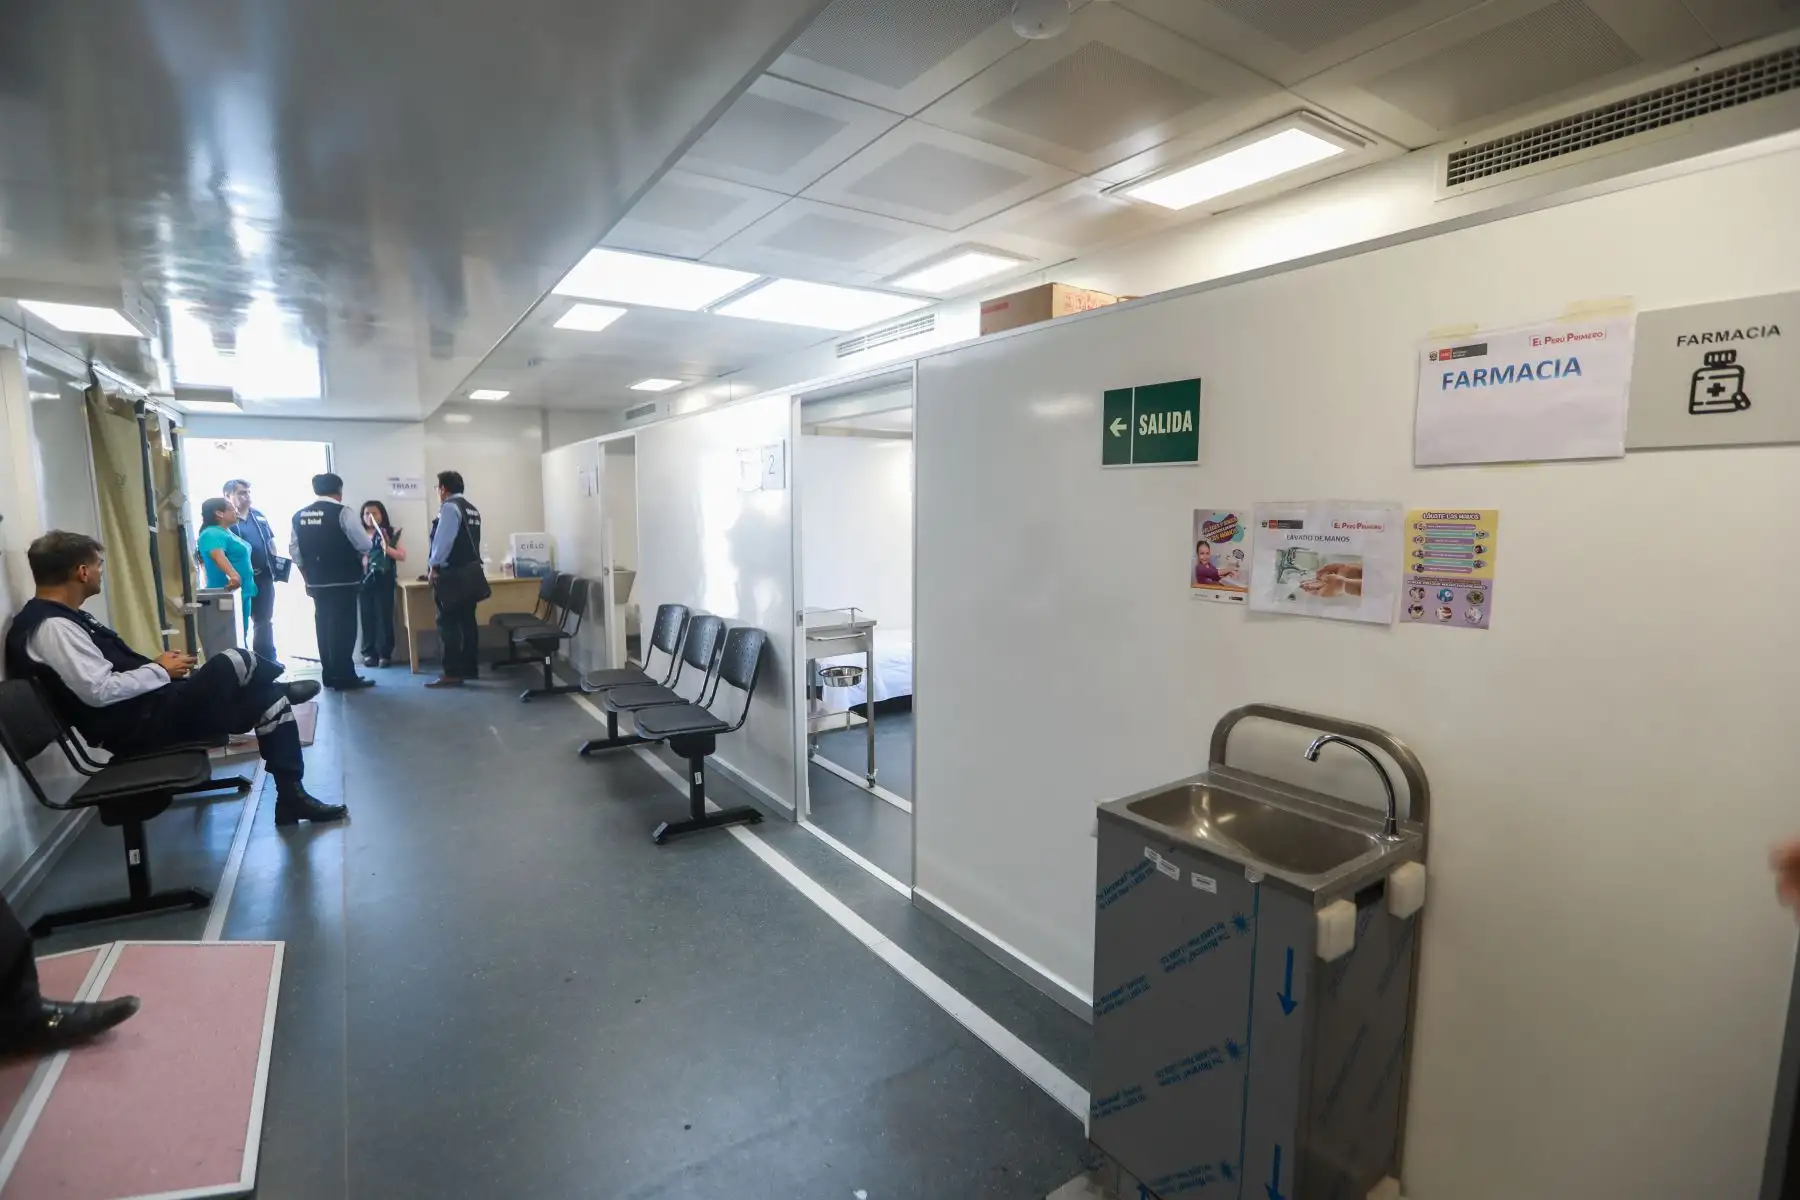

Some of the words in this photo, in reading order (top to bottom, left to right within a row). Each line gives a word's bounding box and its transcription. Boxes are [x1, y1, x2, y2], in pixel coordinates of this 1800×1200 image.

[1566, 331, 1604, 343] PRIMERO
[1676, 324, 1781, 347] FARMACIA
[1441, 356, 1583, 391] FARMACIA
[1138, 409, 1193, 436] SALIDA
[768, 454, 776, 475] 2
[1323, 535, 1350, 543] MANOS
